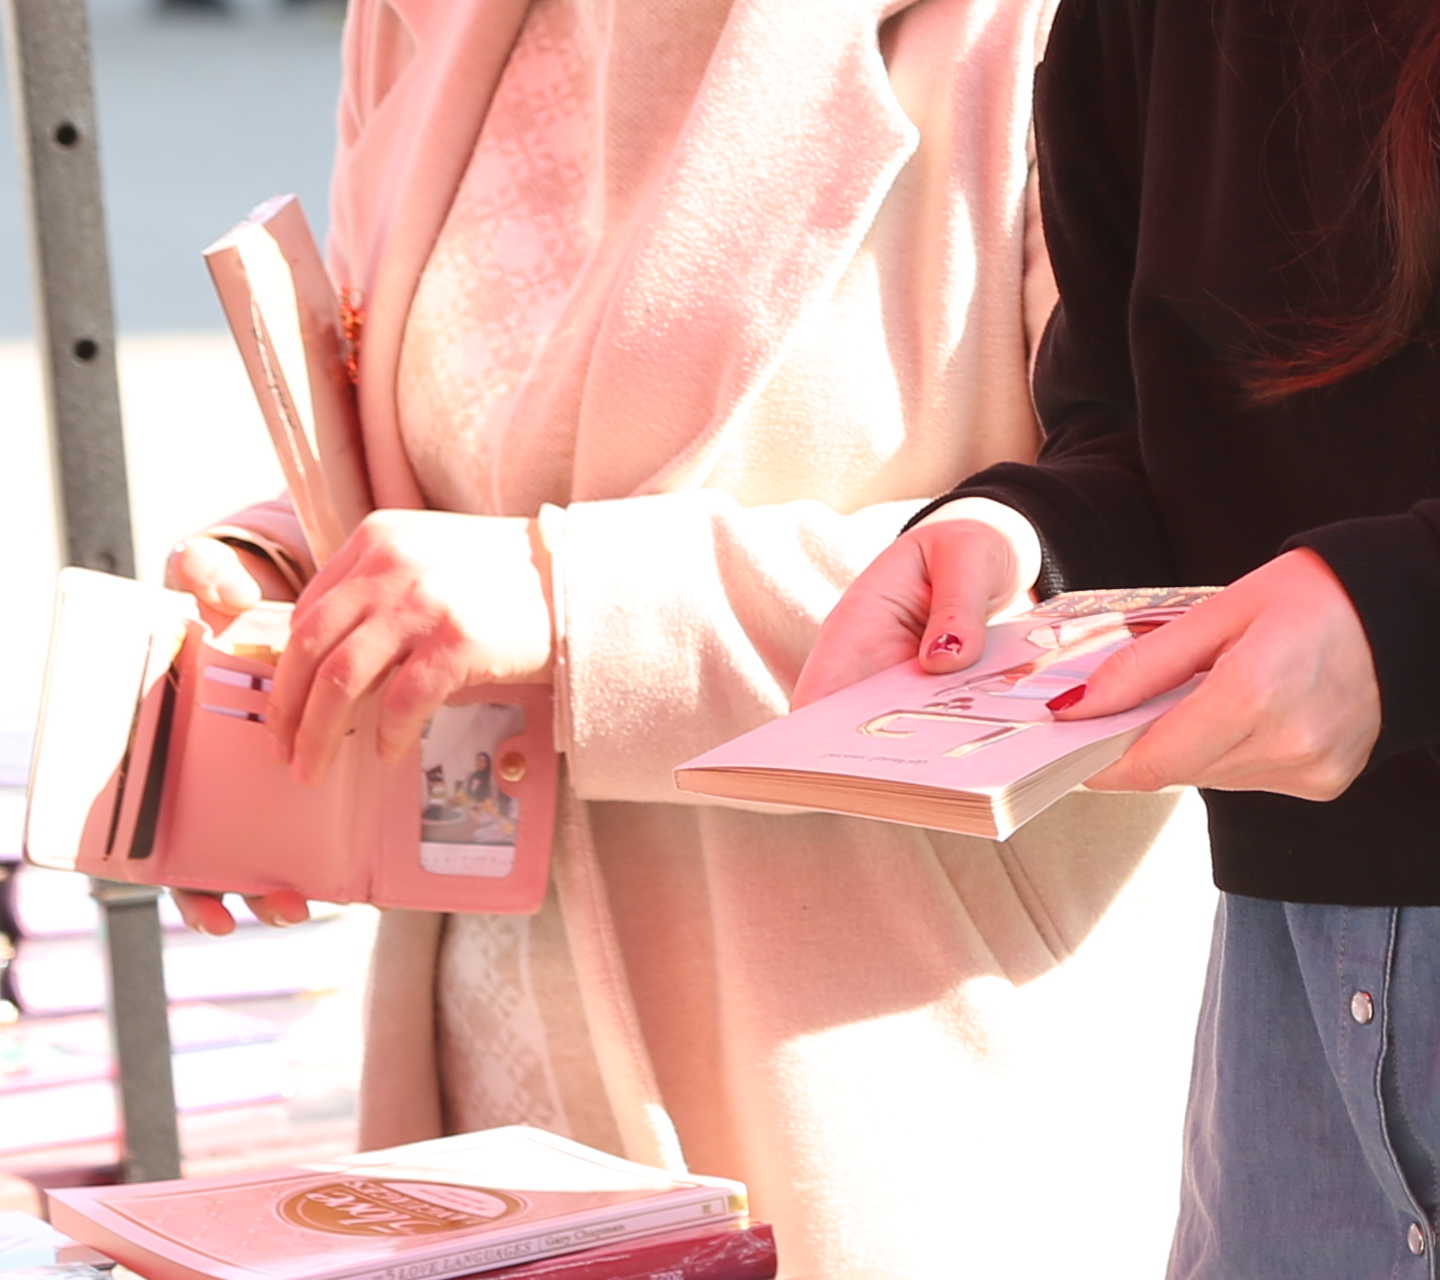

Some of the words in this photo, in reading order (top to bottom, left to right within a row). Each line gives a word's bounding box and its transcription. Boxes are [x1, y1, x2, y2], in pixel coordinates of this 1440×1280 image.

[397, 1262, 438, 1280] LOVE
[441, 1241, 532, 1269] LANGUAGES
[544, 1234, 573, 1247] Gary
[575, 1224, 626, 1243] Chapman
